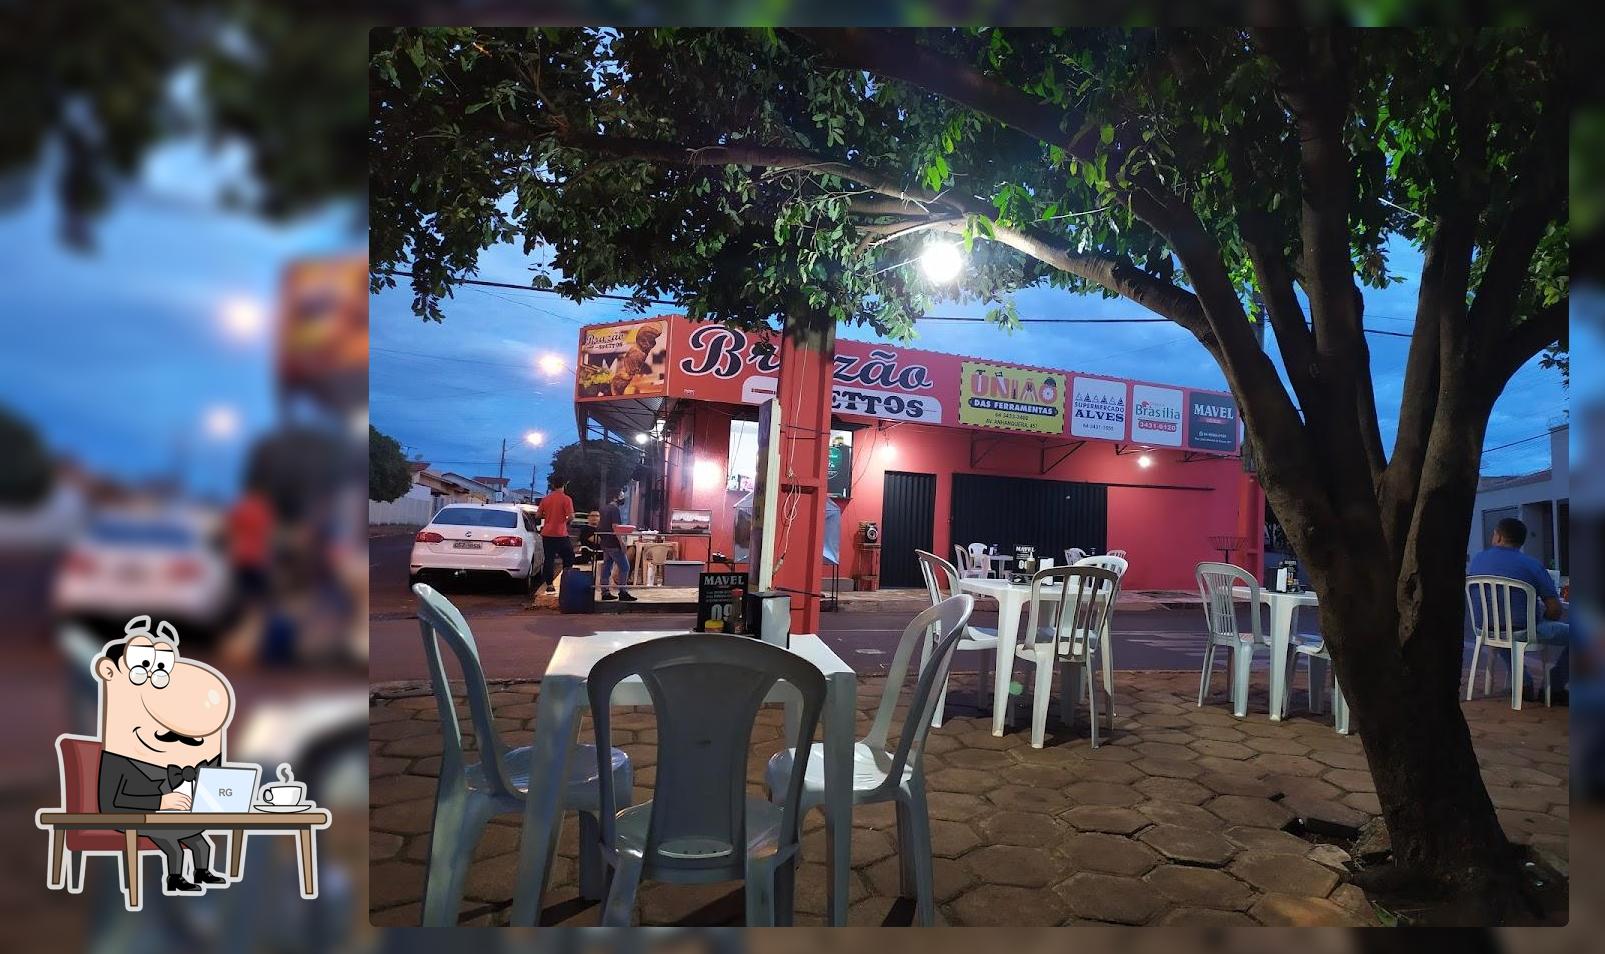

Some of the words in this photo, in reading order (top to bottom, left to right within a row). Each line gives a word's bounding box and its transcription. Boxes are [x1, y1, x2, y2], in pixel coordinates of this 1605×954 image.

[971, 372, 1058, 405] UNIÃO
[974, 399, 991, 408] DAS
[994, 401, 1053, 415] FERRAMENTAS
[1075, 401, 1124, 413] SUPERMERCADO
[1193, 403, 1234, 419] MAVEL
[1075, 409, 1124, 423] ALVES
[703, 575, 745, 586] MAVEL
